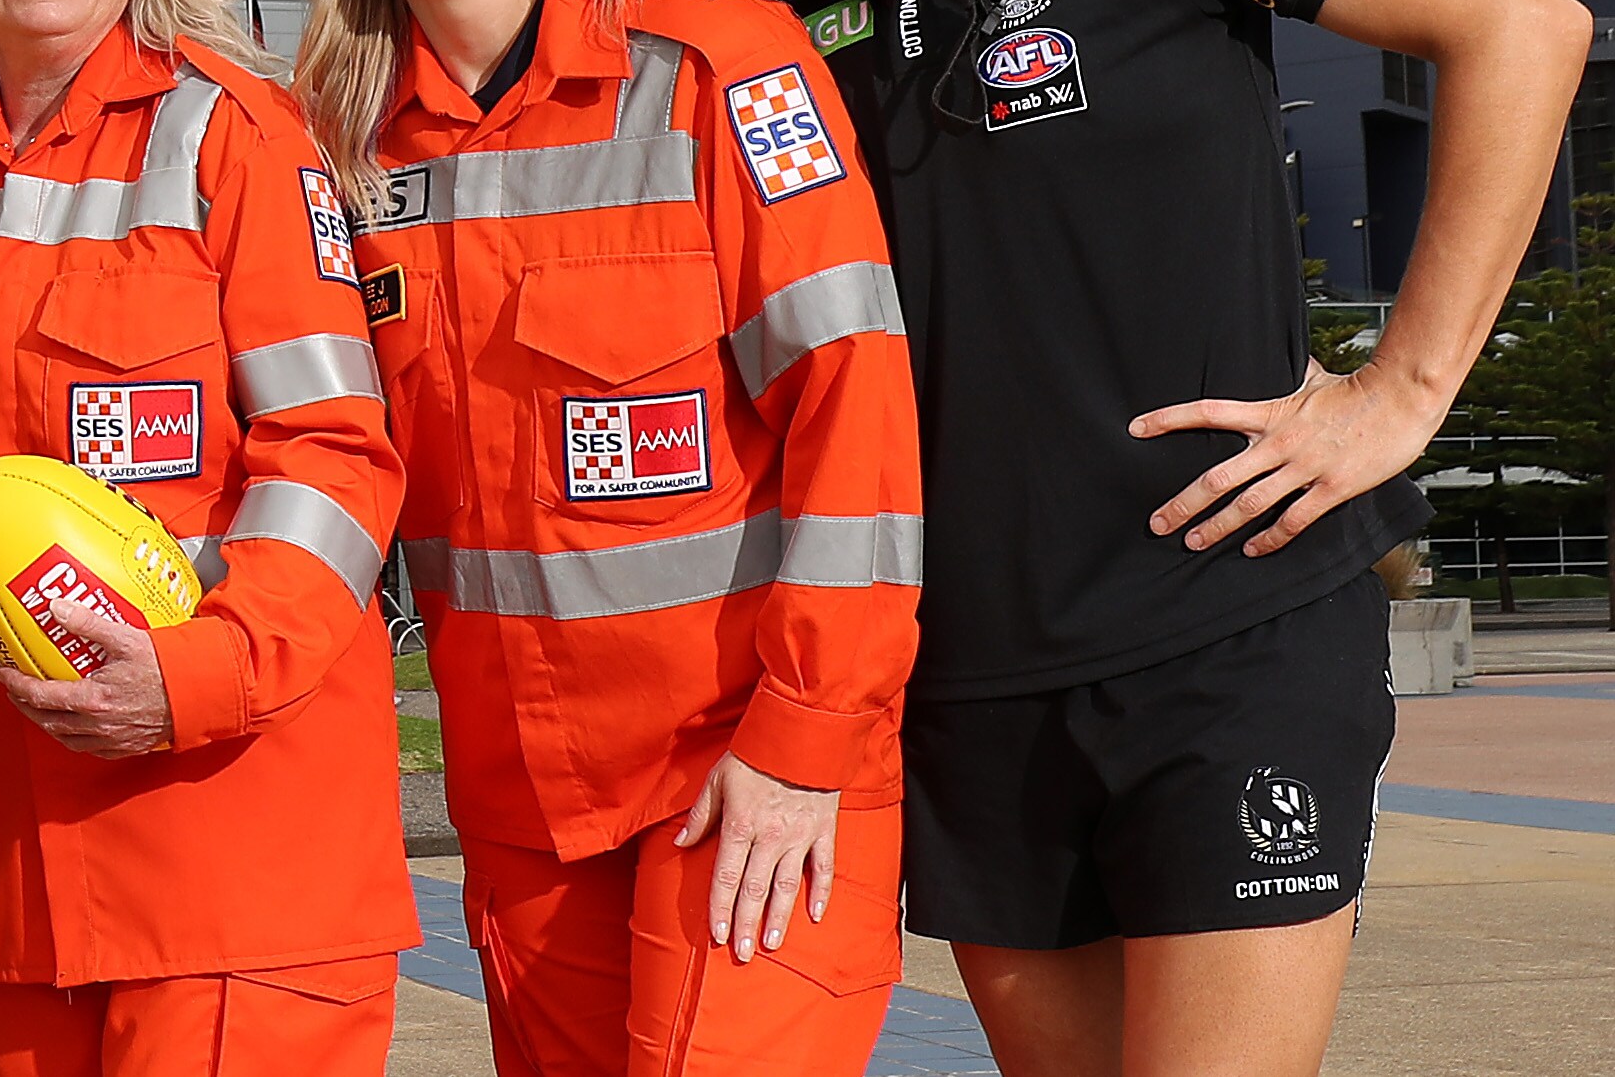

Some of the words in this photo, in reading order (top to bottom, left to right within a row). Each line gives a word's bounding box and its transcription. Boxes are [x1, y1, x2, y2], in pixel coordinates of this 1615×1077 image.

[806, 0, 868, 48] GU
[989, 37, 1068, 82] AFL
[1010, 92, 1042, 113] nab
[745, 112, 818, 156] SES
[314, 211, 350, 245] SES
[76, 418, 123, 438] SES
[134, 414, 192, 438] AAMI
[634, 425, 696, 452] AAMI
[572, 433, 622, 453] SES
[99, 469, 107, 477] A
[109, 467, 137, 477] SAFER
[138, 463, 195, 476] COMMUNITY
[575, 484, 595, 494] FOR
[598, 484, 607, 493] A
[608, 482, 637, 492] SAFER
[640, 475, 702, 491] COMMUNITY
[21, 586, 95, 678] WAREH
[1235, 873, 1340, 899] COTTON:ON
